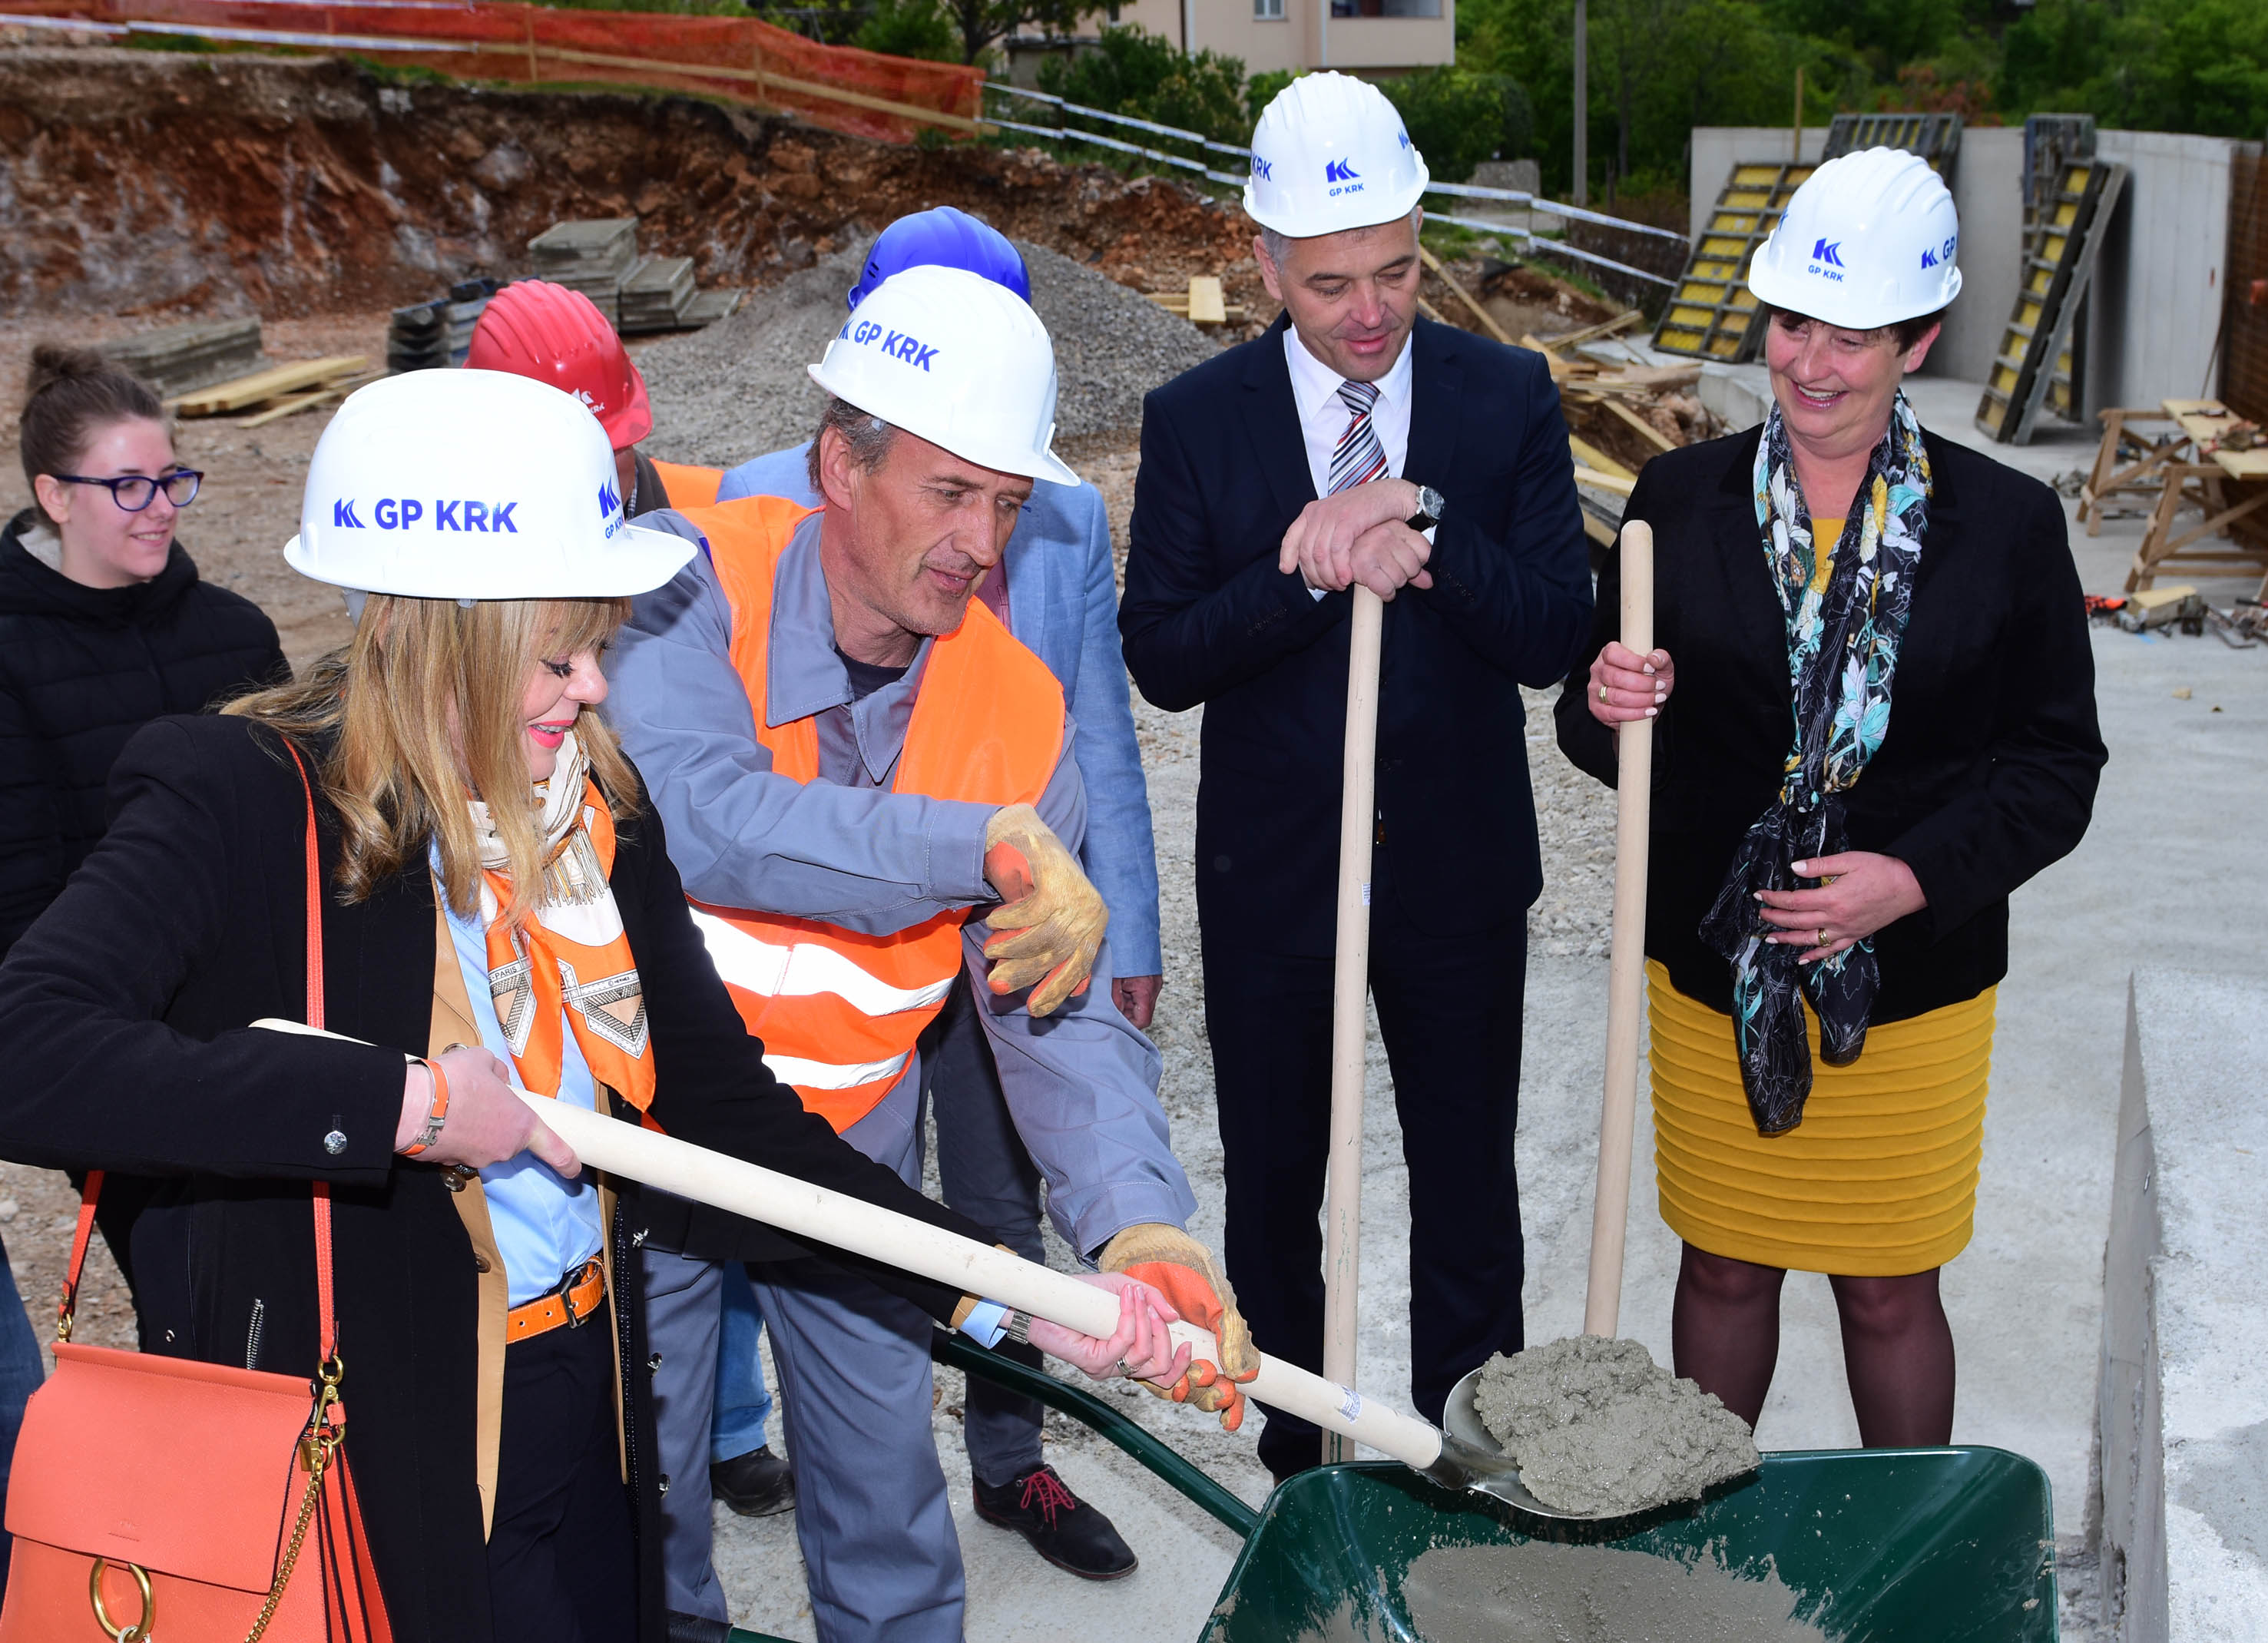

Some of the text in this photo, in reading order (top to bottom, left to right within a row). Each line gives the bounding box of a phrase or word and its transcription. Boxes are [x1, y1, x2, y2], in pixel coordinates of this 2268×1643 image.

[1329, 183, 1364, 197] GP KRK
[1943, 235, 1955, 260] GP
[1808, 264, 1844, 283] GP KRK
[854, 320, 882, 346] GP
[881, 330, 941, 373] KRK
[374, 498, 423, 530] GP
[436, 499, 518, 533] KRK
[605, 524, 614, 538] GP
